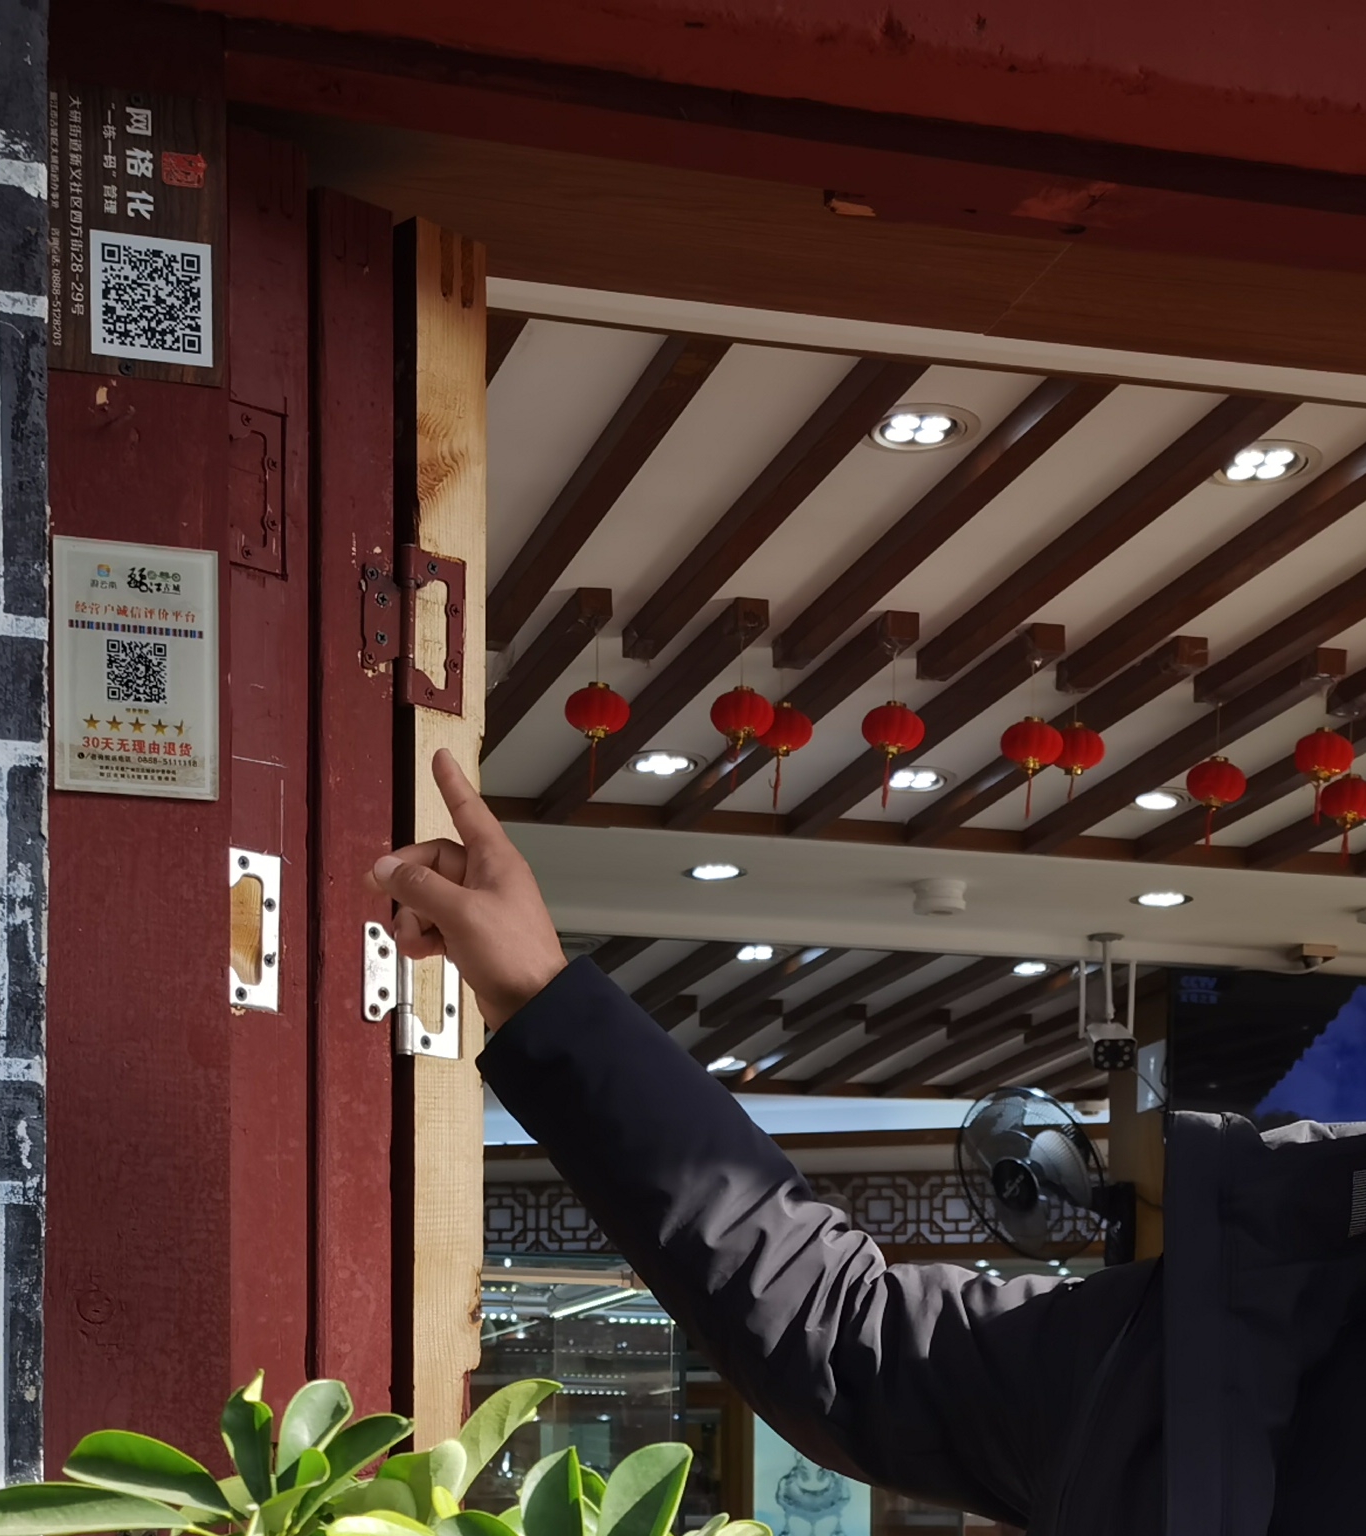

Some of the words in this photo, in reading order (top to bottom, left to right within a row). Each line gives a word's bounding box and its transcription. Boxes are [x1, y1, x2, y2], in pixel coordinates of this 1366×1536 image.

[125, 106, 154, 221] 网格化
[75, 600, 196, 623] 经营户诚信评价平台
[82, 736, 193, 757] 30天无理由退货
